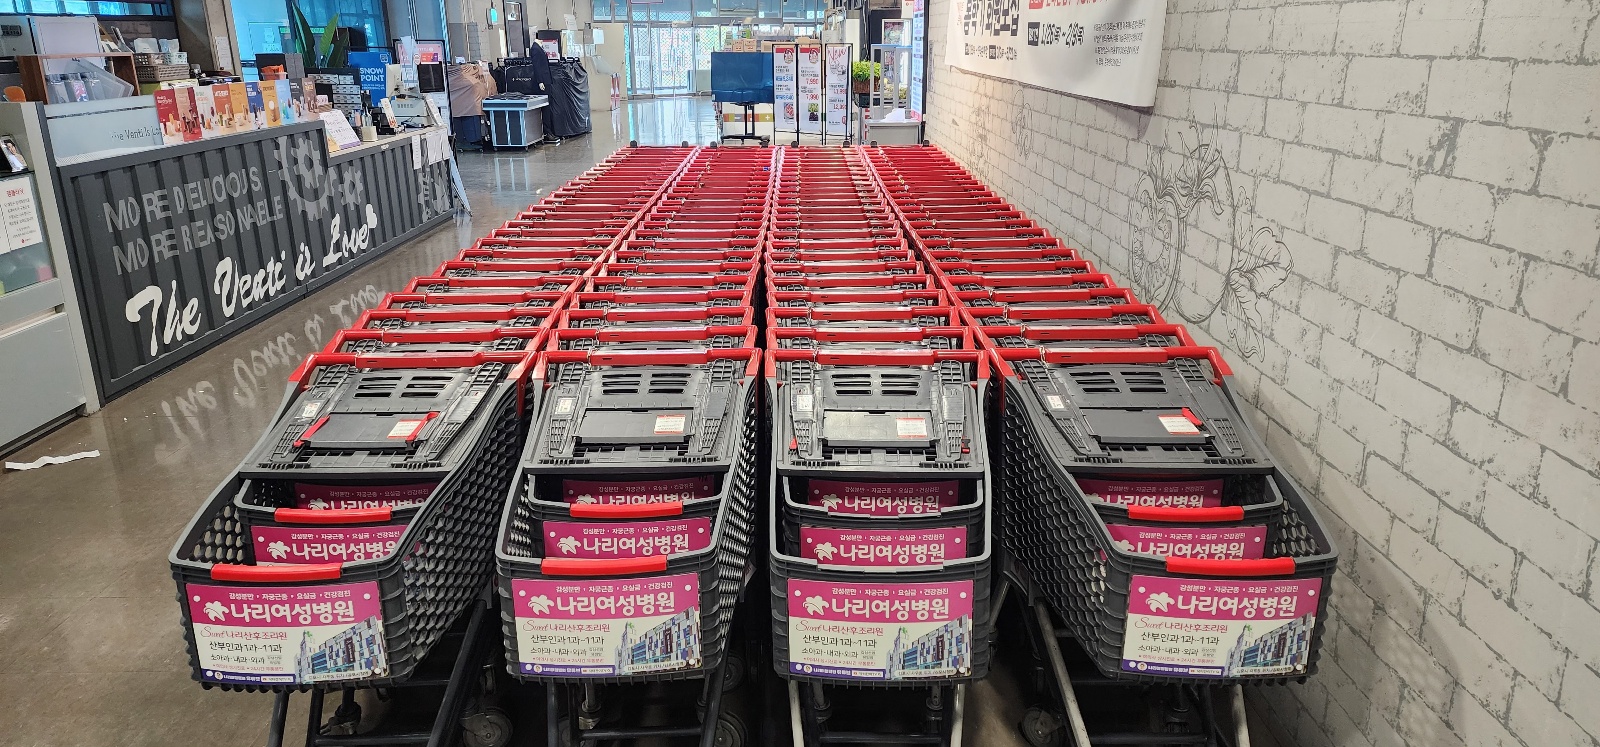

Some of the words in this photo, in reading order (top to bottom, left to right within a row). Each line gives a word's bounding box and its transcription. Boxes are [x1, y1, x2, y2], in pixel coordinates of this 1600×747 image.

[103, 190, 172, 233] MORE
[113, 229, 179, 275] MORE
[125, 280, 202, 357] The
[214, 250, 287, 318] Venti
[296, 242, 316, 281] is
[844, 495, 939, 514] 나리여성병원
[291, 532, 315, 540] 감성분만
[321, 532, 344, 541] 자궁근종
[352, 532, 370, 540] 요실금
[377, 531, 400, 539] 건강검진
[583, 534, 689, 556] 나리여성병원
[1139, 531, 1163, 539] 감성분만
[1170, 532, 1193, 540] 자궁근종
[840, 544, 945, 563] 나리여성병원
[1138, 542, 1245, 560] 나리여성병원
[262, 593, 288, 601] 자궁근종
[296, 592, 316, 600] 요실금
[324, 590, 351, 599] 건강검진
[589, 585, 614, 593] 자궁근종
[649, 582, 673, 590] 건강검진
[832, 588, 857, 596] 감성분만
[924, 588, 949, 596] 건강검진
[1180, 584, 1206, 592] 감성분만
[1214, 586, 1240, 594] 자궁근종
[1248, 586, 1267, 594] 요실금
[1274, 585, 1299, 593] 건강검진
[231, 601, 355, 625] 나리여성병원
[557, 592, 675, 616] 나리여성병원
[831, 598, 949, 620] 나리여성병원
[1177, 595, 1297, 618] 나리여성병원
